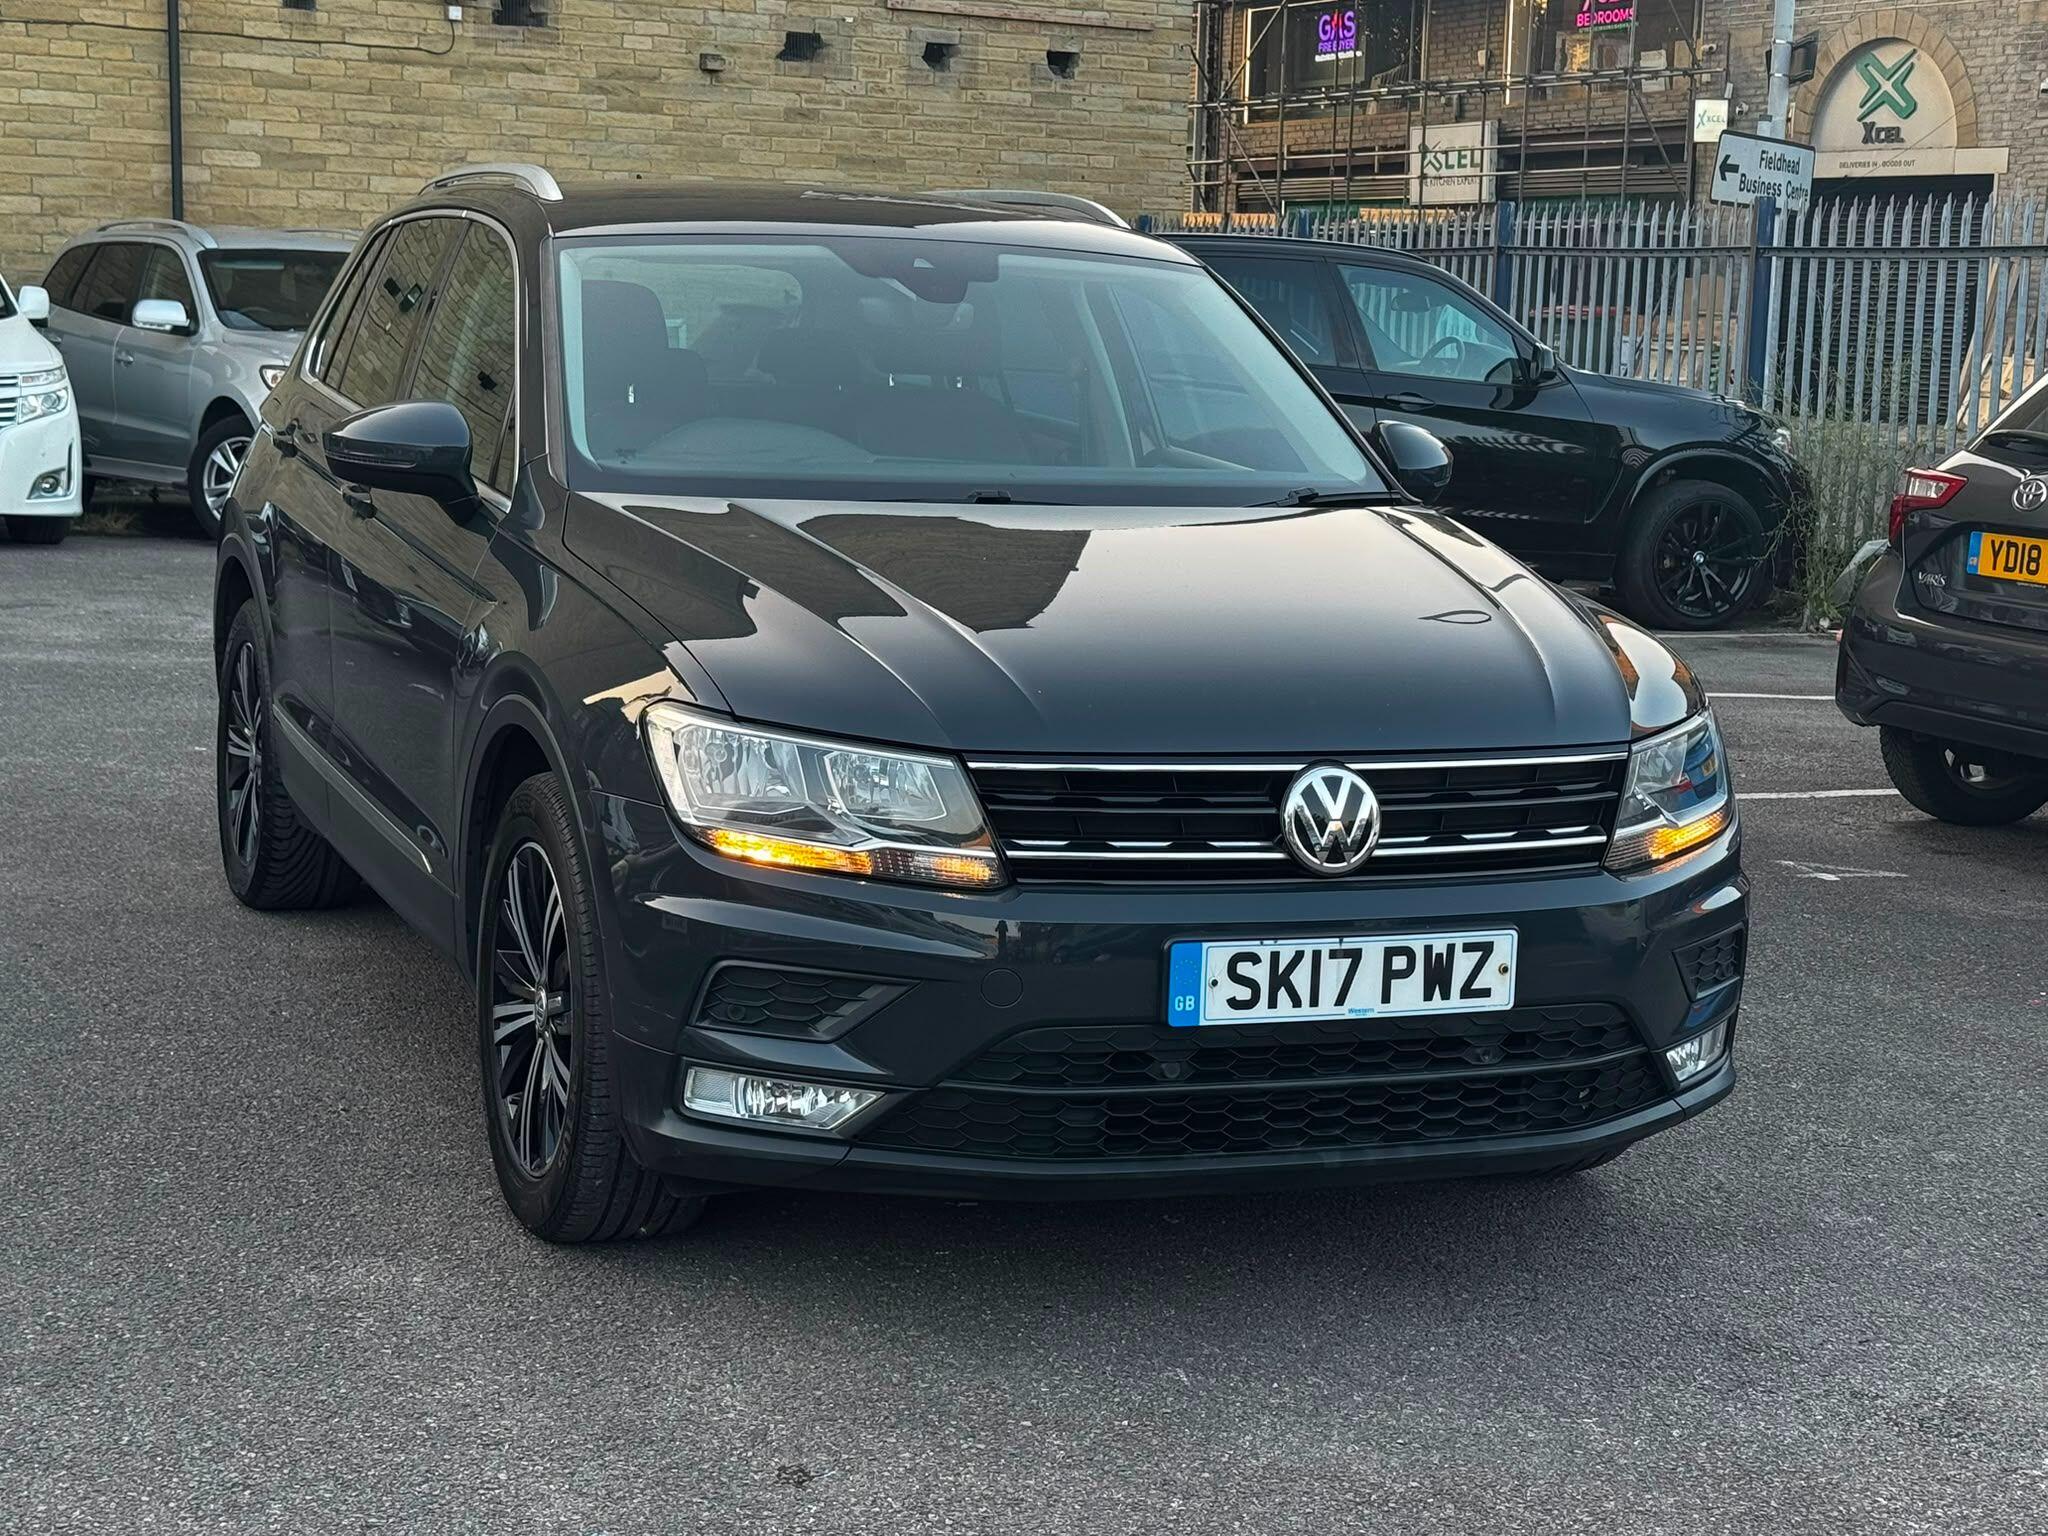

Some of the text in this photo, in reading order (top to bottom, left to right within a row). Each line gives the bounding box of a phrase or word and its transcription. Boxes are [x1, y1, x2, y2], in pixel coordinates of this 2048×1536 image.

[1319, 10, 1355, 41] GAS
[1759, 150, 1801, 175] Fieldhead
[1739, 173, 1809, 202] Business Centre
[1991, 539, 2042, 576] YD18
[1225, 941, 1495, 1010] SK17 PWZ
[1174, 995, 1196, 1011] GB
